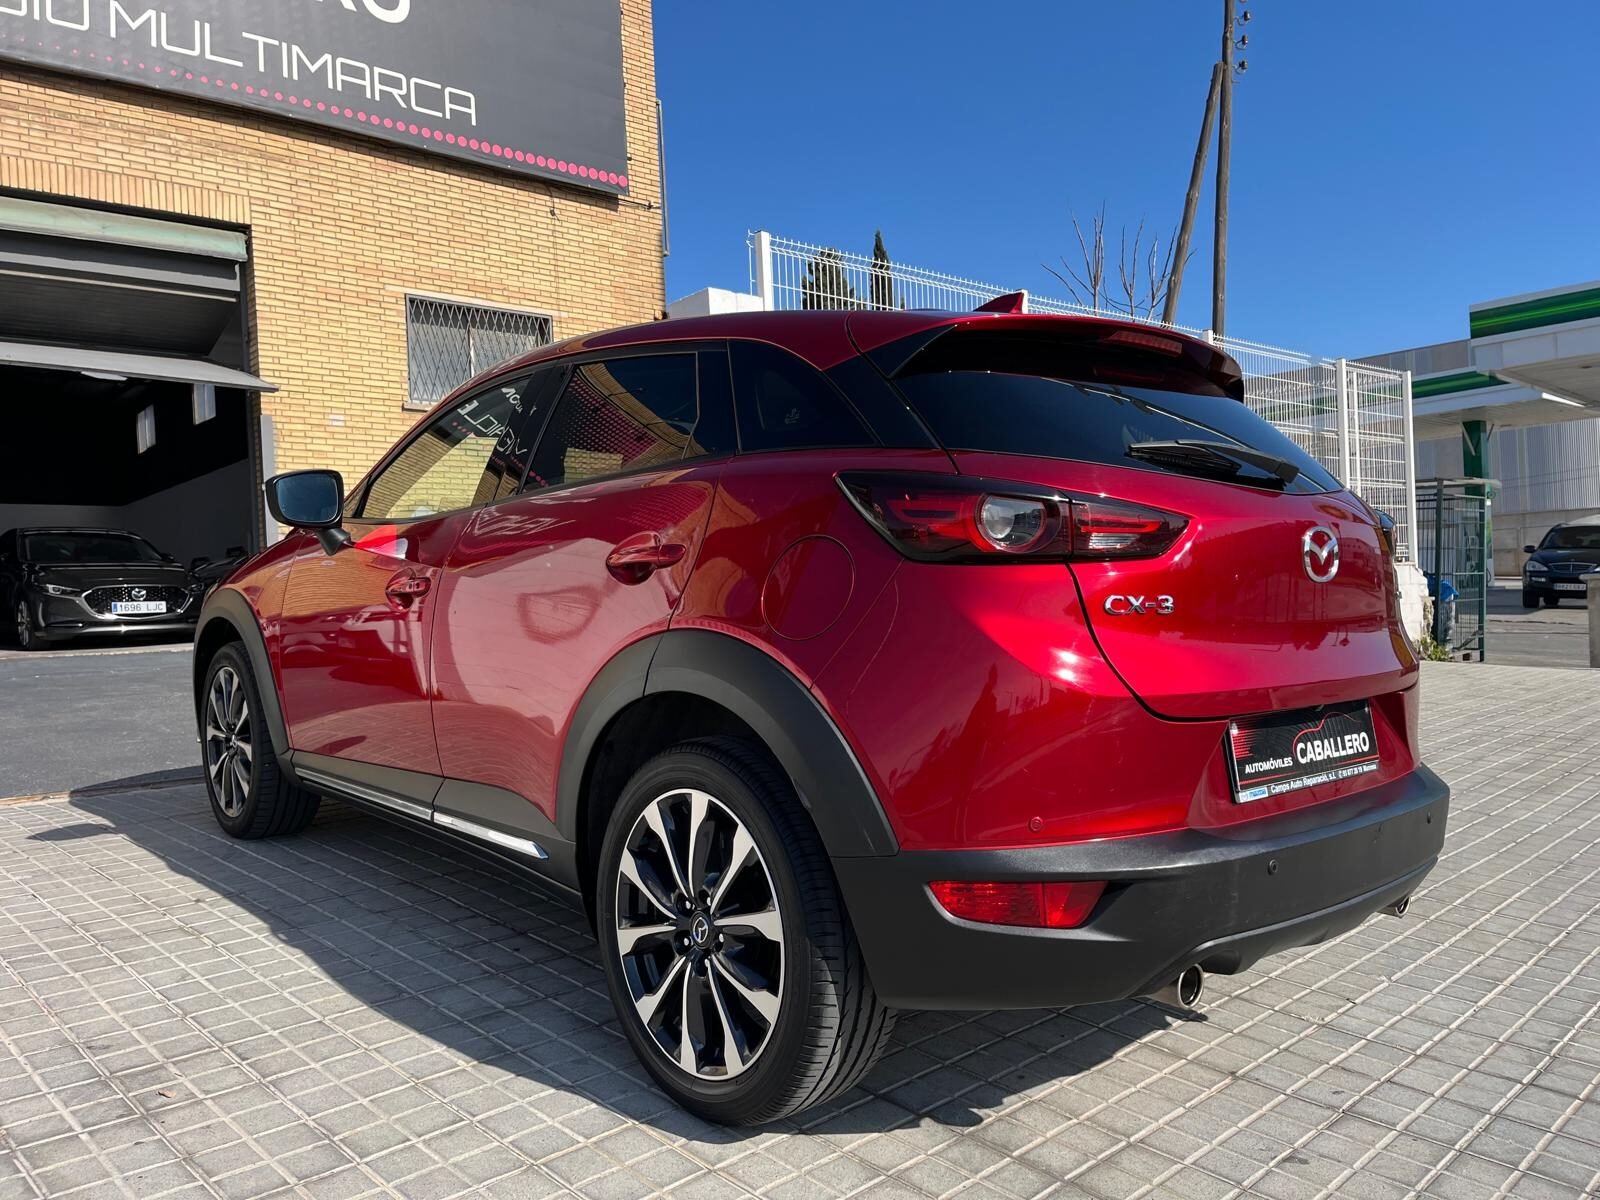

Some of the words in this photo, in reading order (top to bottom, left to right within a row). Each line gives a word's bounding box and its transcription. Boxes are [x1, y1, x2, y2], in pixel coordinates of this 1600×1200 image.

[109, 0, 477, 127] MULTIMARCA
[119, 603, 141, 612] 1696
[146, 603, 163, 611] LJC
[1104, 594, 1174, 615] CX-3
[1245, 757, 1293, 774] AUTOMÓVILES
[1296, 731, 1370, 764] CABALLERO
